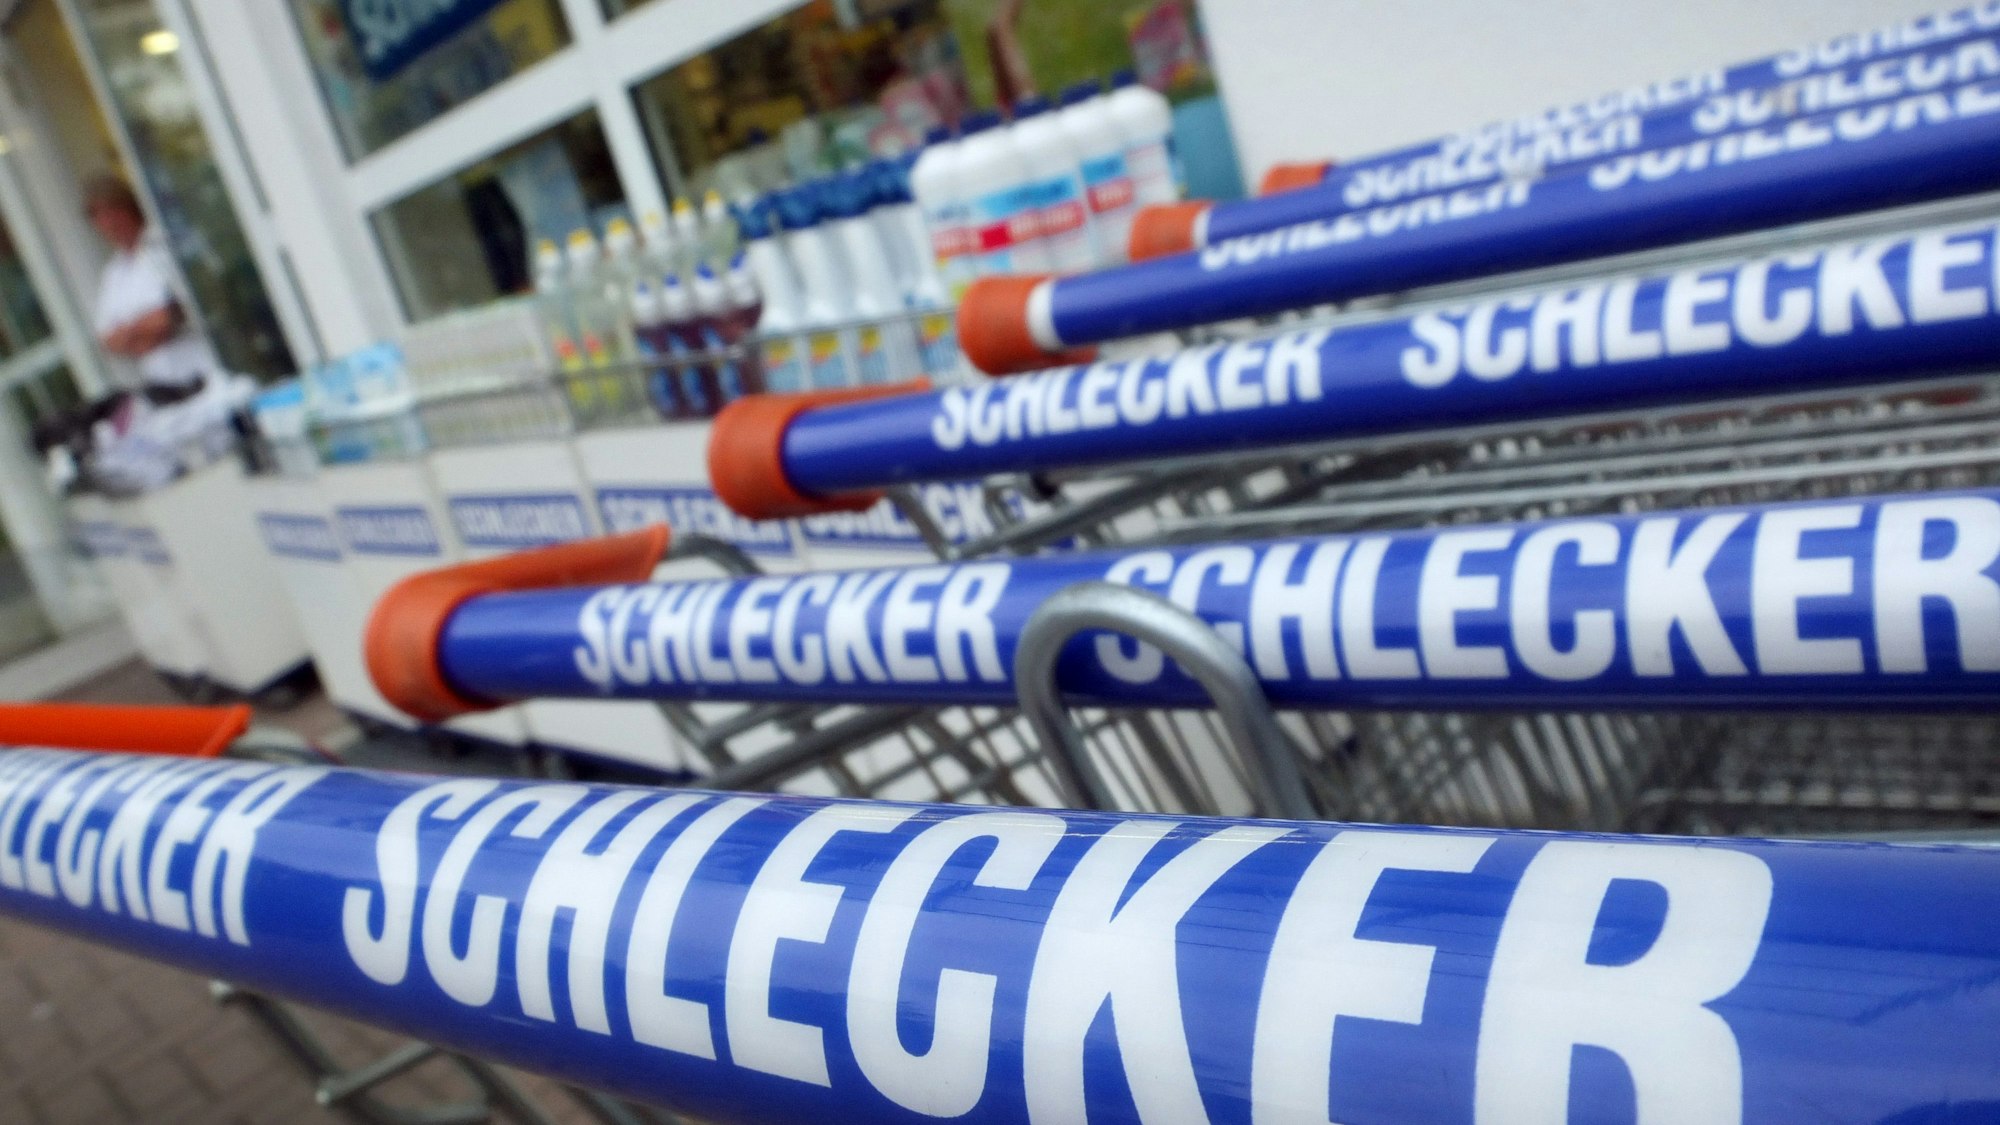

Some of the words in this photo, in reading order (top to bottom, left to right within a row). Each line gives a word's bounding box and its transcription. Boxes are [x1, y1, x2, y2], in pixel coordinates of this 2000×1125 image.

[931, 328, 1324, 450] SCHLECKER
[1401, 225, 2000, 389] SCHLECKE
[574, 563, 1010, 684] SCHLECKER
[0, 748, 318, 947] LECKER
[342, 778, 1774, 1125] SCHLECKER
